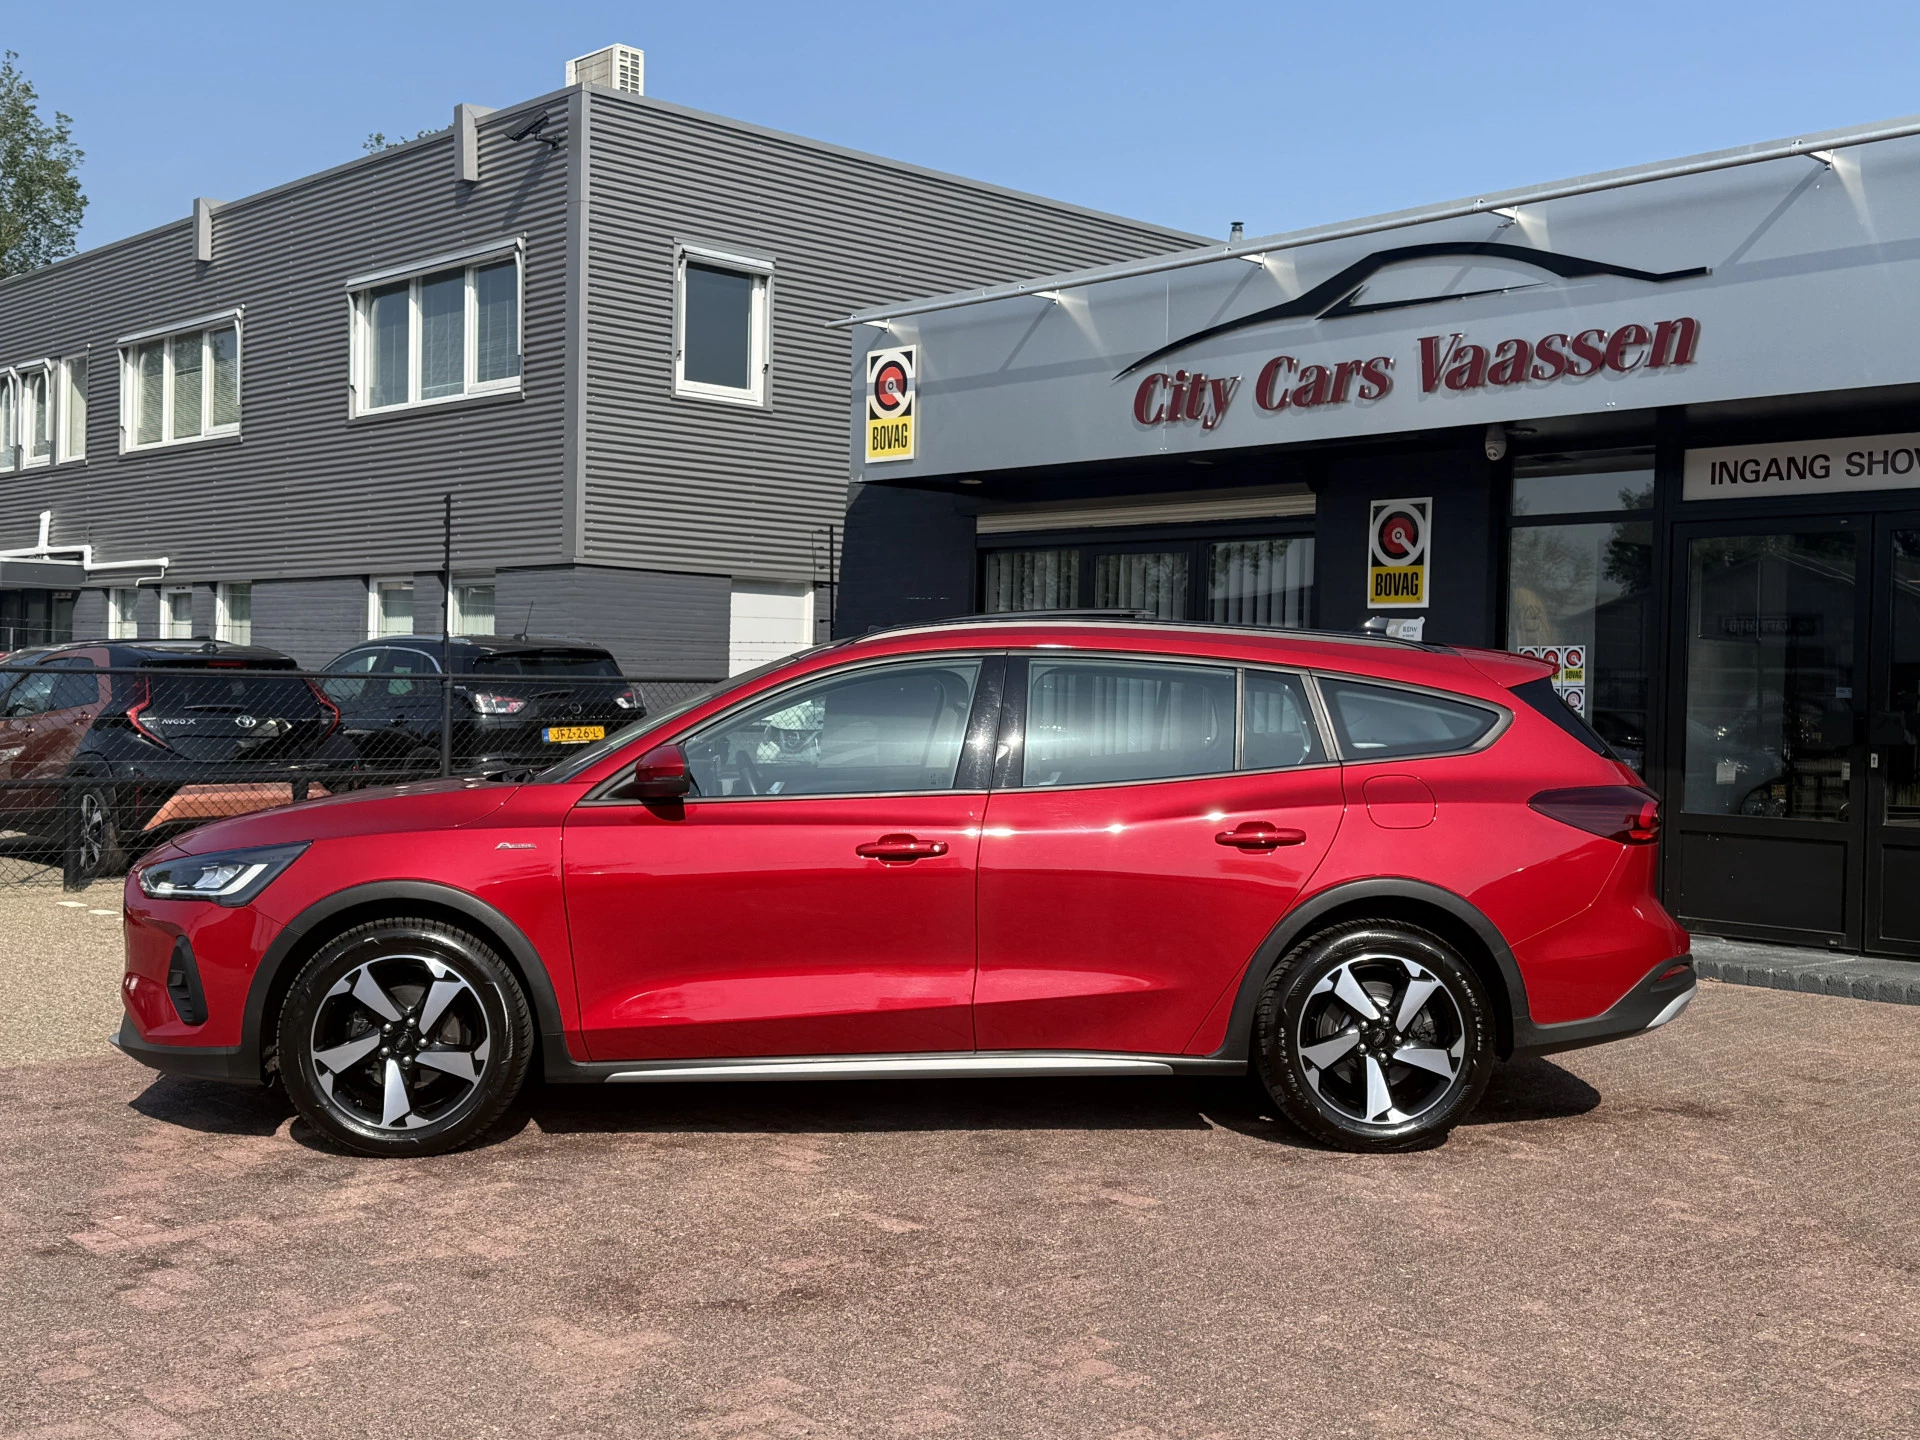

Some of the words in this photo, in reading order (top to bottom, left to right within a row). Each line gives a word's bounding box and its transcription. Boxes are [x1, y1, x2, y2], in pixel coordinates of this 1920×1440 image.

[1133, 371, 1241, 429] City
[1255, 355, 1395, 411] Cars
[1418, 315, 1699, 394] Vaassen
[872, 423, 908, 451] BOVAG
[1710, 454, 1831, 486] INGANG
[1375, 572, 1419, 597] BOVAG
[1565, 670, 1583, 680] BOVAG
